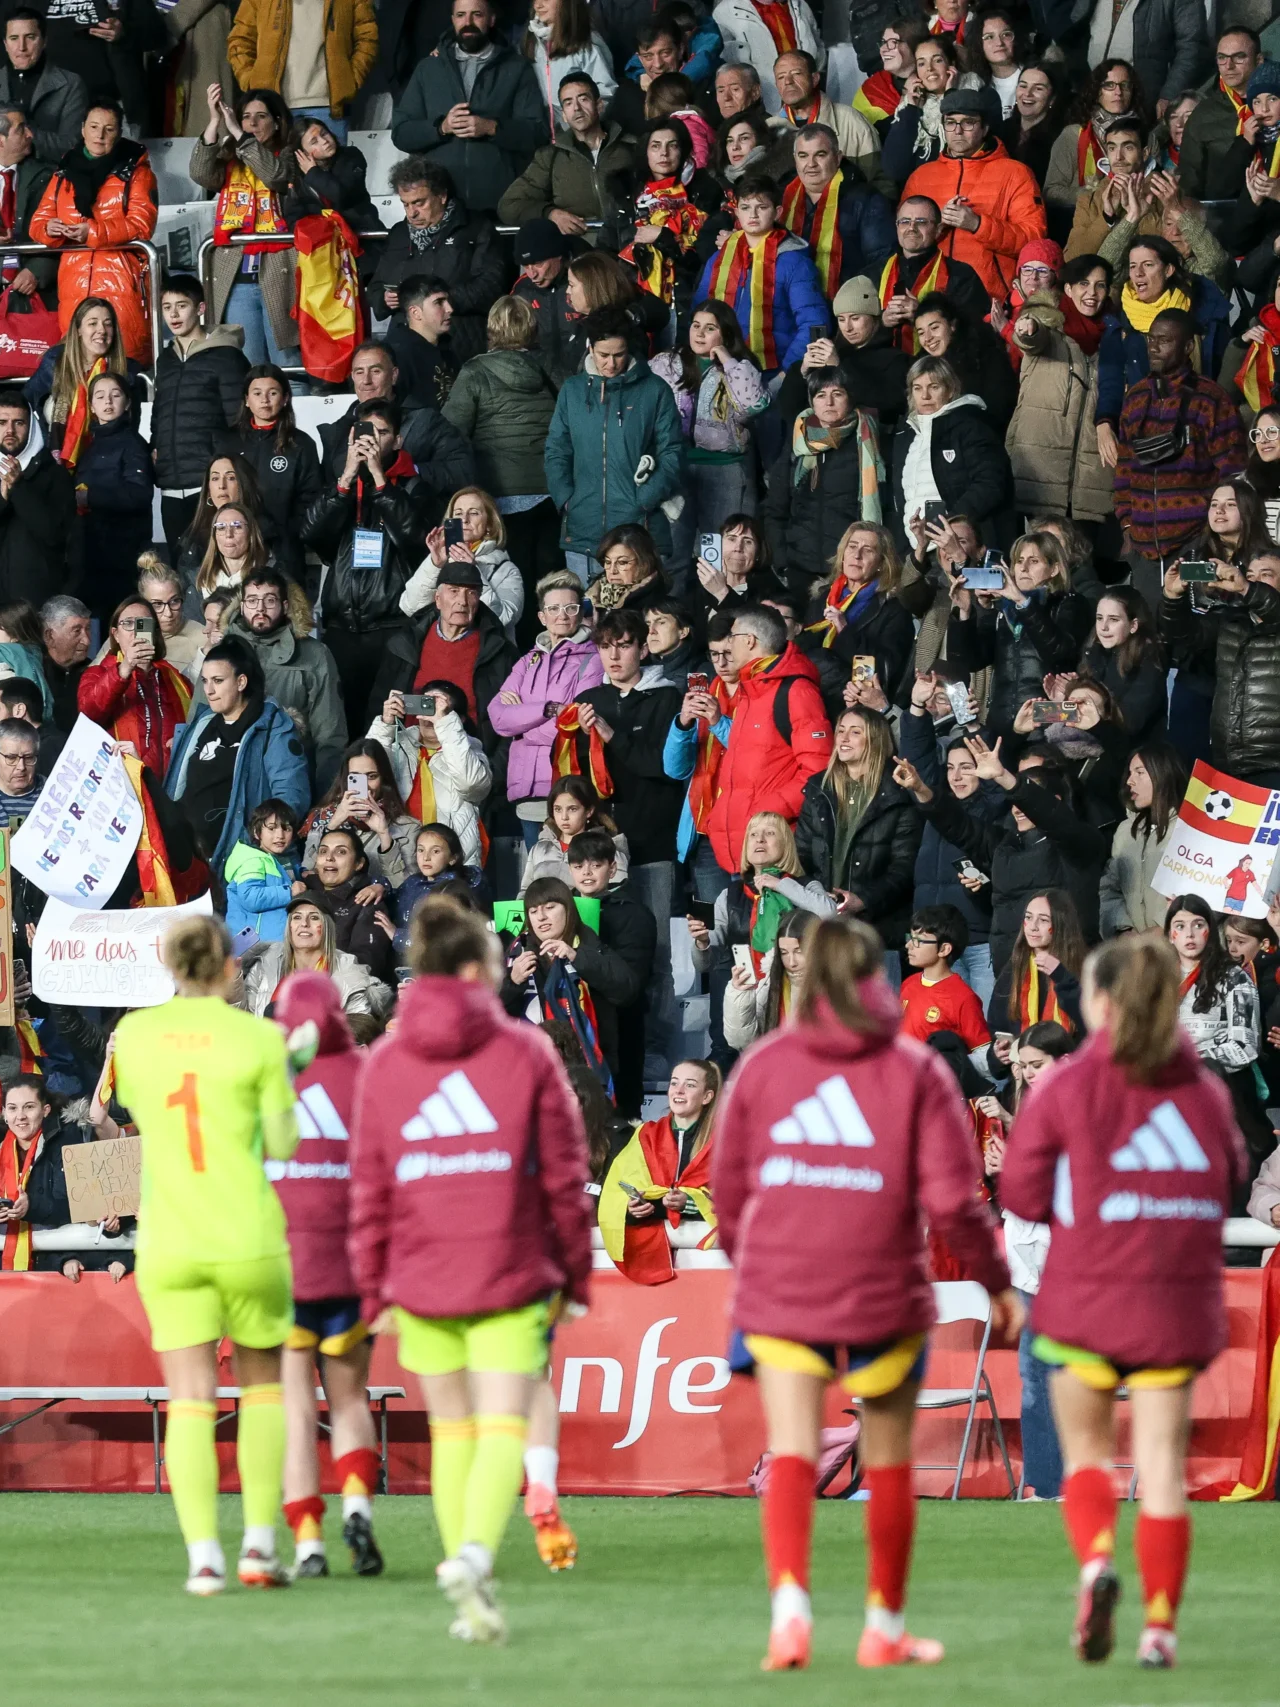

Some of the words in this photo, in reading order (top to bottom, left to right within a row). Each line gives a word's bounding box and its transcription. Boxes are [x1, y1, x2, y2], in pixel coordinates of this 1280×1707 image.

[30, 750, 86, 839] IRENE
[36, 819, 76, 872] HEMOS
[68, 741, 114, 821] RECORRIDO
[88, 801, 110, 831] 100
[75, 854, 110, 897] PARA
[104, 793, 137, 843] VERT
[1254, 826, 1280, 846] ES
[1162, 855, 1226, 887] CARMONA
[1177, 845, 1214, 868] OLGA
[45, 939, 86, 962] me
[96, 937, 137, 963] das
[148, 935, 167, 965] t
[38, 962, 169, 998] CAMISET
[166, 1073, 206, 1173] 1
[558, 1316, 732, 1450] nfe
